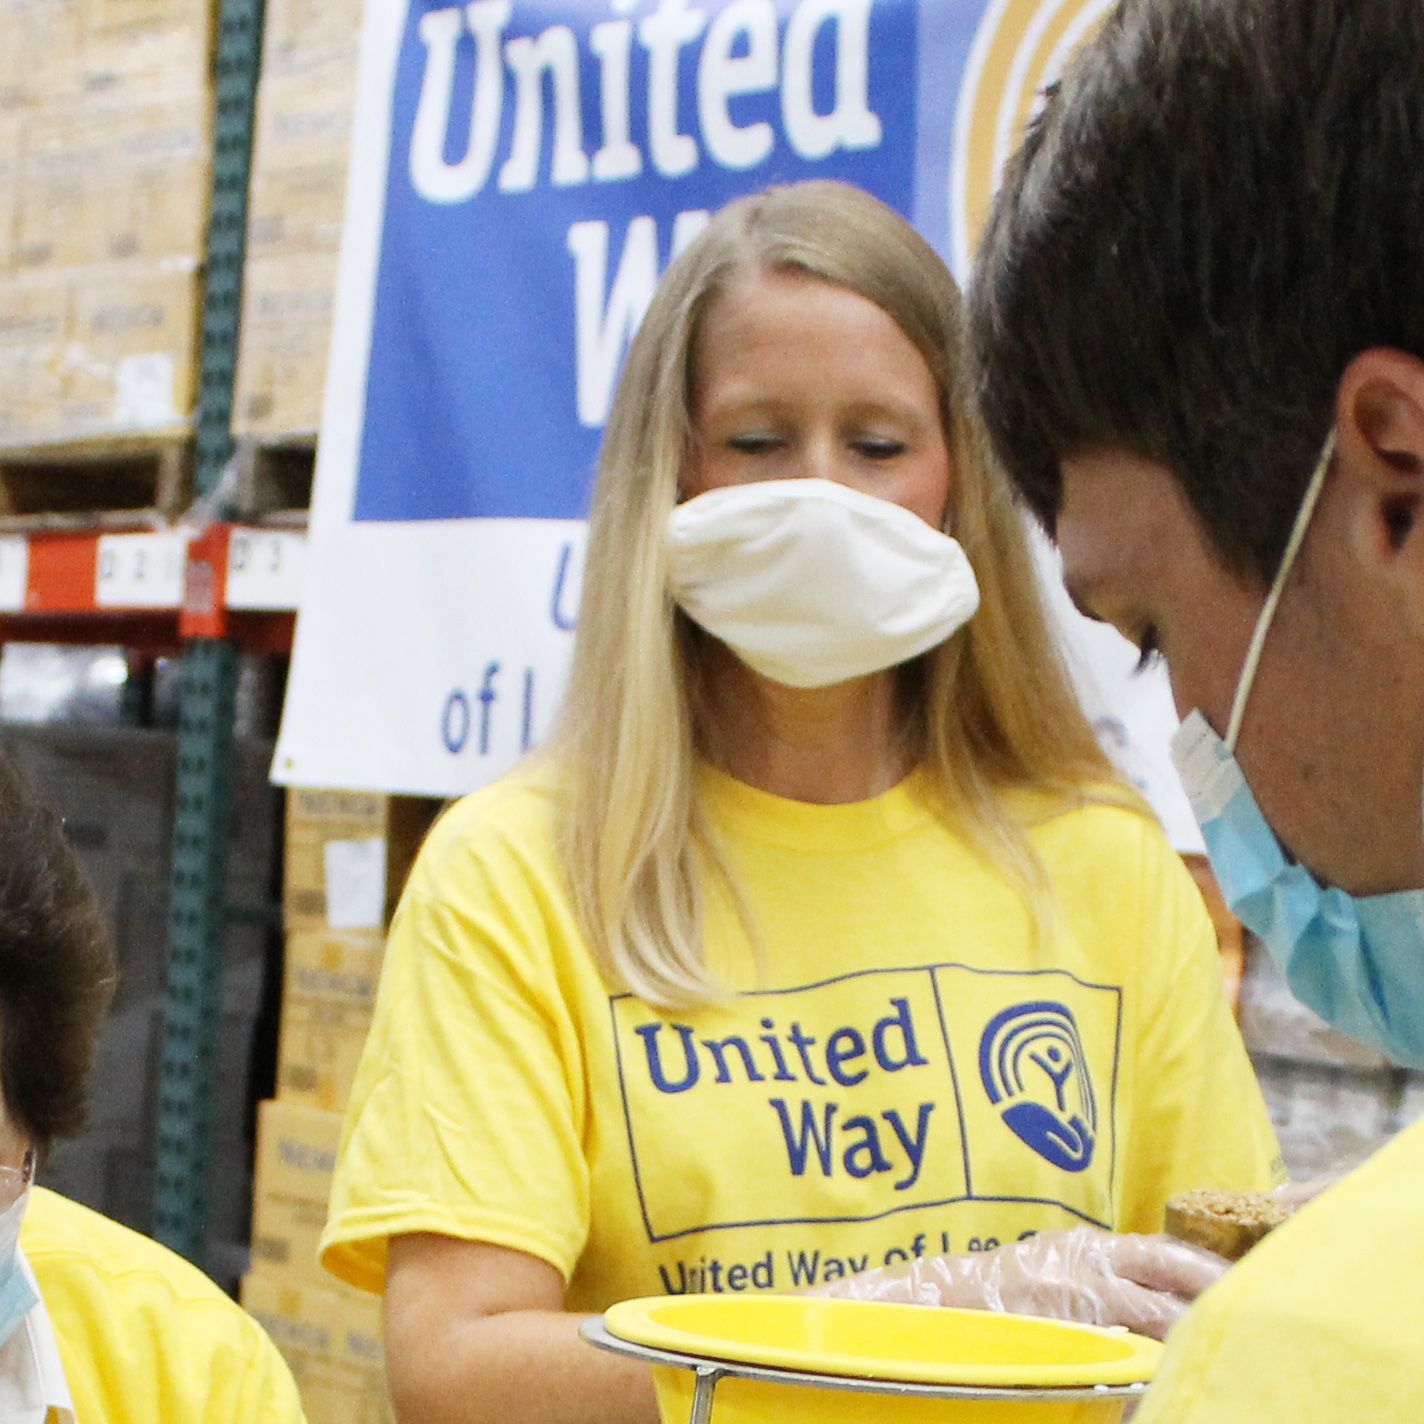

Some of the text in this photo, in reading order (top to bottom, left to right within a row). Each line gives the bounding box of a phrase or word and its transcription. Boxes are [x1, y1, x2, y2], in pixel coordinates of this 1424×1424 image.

[409, 0, 882, 202] United
[441, 660, 501, 756] of
[634, 997, 930, 1094] United
[768, 1097, 936, 1191] Way
[659, 1250, 775, 1296] Uited
